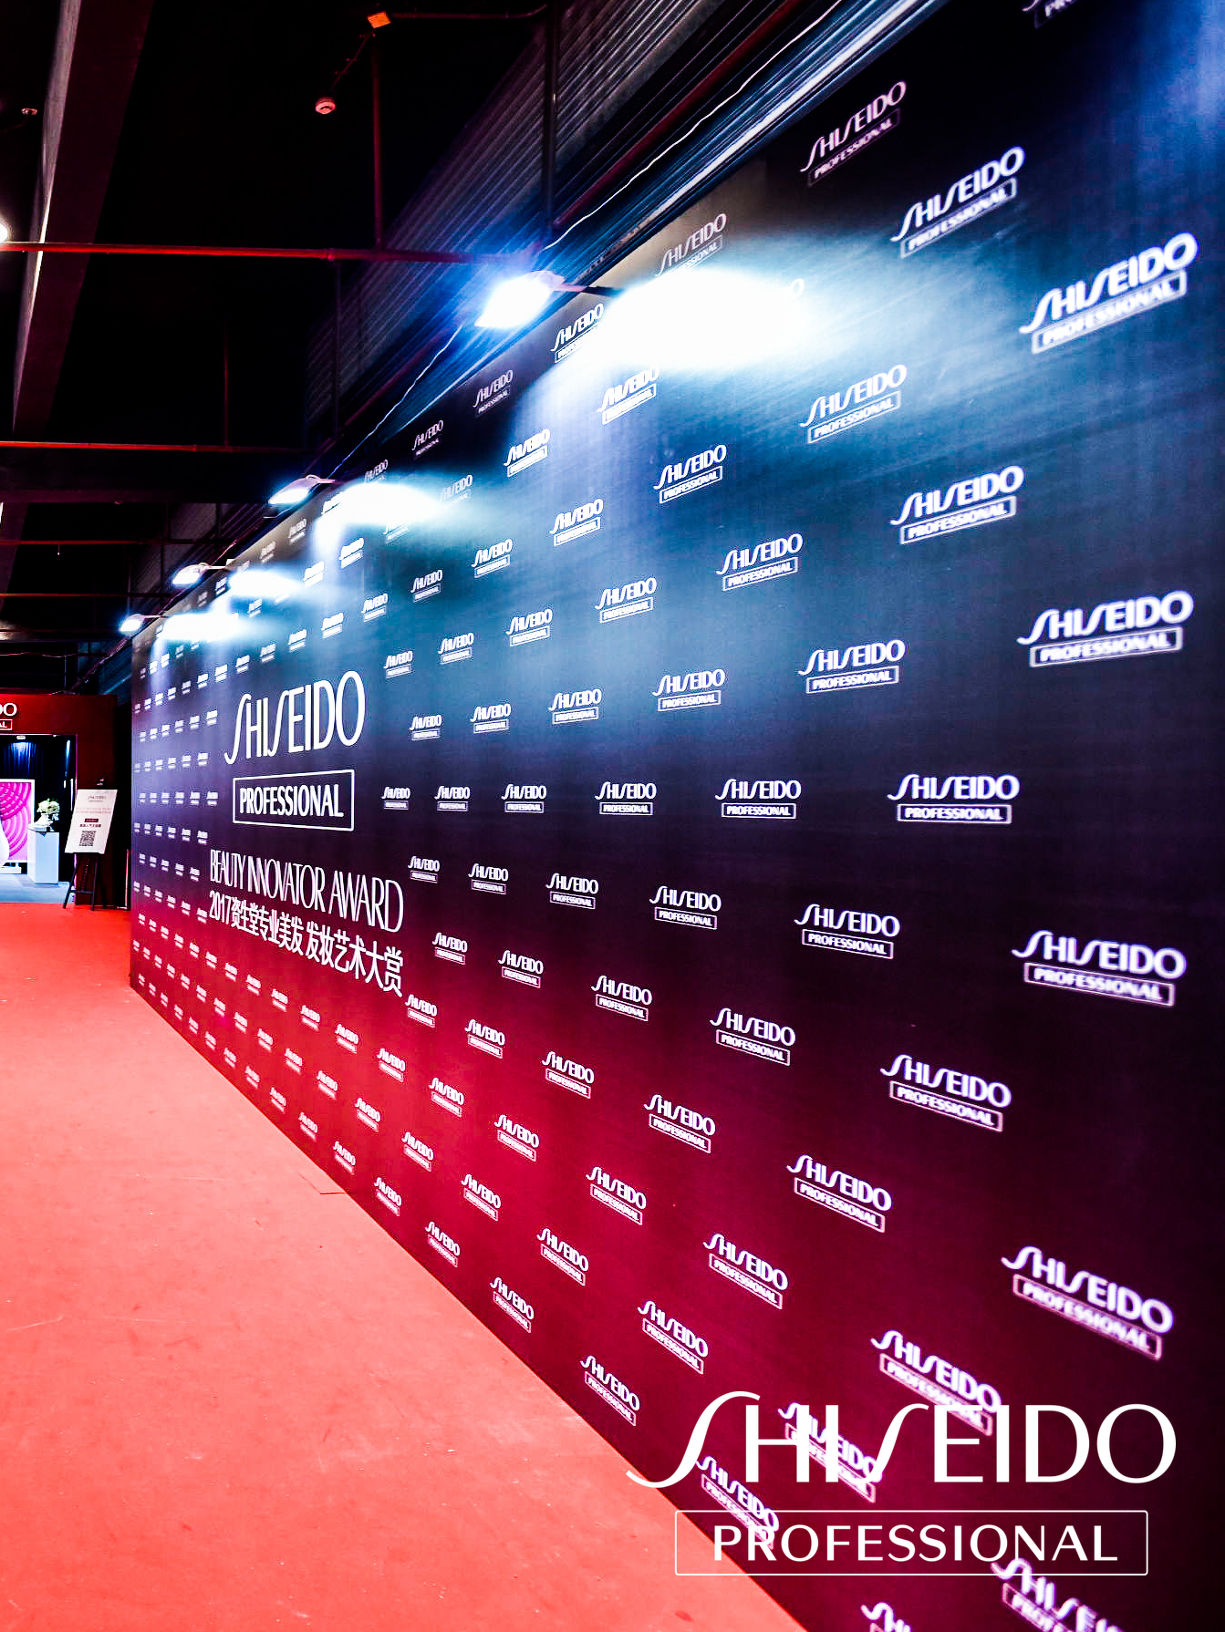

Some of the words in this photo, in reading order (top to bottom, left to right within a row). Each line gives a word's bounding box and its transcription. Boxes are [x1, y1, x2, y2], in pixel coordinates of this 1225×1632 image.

[800, 81, 906, 174] SHISEIDO
[814, 117, 894, 177] PROFESSIONAL
[890, 146, 1025, 243] SHISEIDO
[907, 187, 1008, 250] PROFESSIONAL
[655, 213, 727, 277] SHISEIDO
[1019, 233, 1198, 334] SHISEIDO
[550, 303, 604, 352] SHISEIDO
[1042, 279, 1175, 346] PROFESSIONAL
[472, 369, 514, 408] SHISEIDO
[800, 365, 906, 428] SHISEIDO
[815, 398, 894, 438] PROFESSIONAL
[503, 428, 551, 467] SHISEIDO
[654, 445, 726, 490] SHISEIDO
[664, 471, 718, 500] PROFESSIONAL
[890, 467, 1022, 525] SHISEIDO
[549, 499, 603, 534] SHISEIDO
[909, 503, 1007, 539] PROFESSIONAL
[471, 540, 512, 568] SHISEIDO
[716, 534, 802, 575] SHISEIDO
[728, 562, 792, 587] PROFESSIONAL
[594, 578, 657, 610] SHISEIDO
[505, 609, 553, 635] SHISEIDO
[1018, 594, 1191, 644] SHISEIDO
[798, 640, 904, 675] SHISEIDO
[1041, 634, 1170, 662] PROFESSIONAL
[652, 669, 725, 696] SHISEIDO
[813, 670, 892, 690] PROFESSIONAL
[224, 670, 366, 765] SHISEIDO
[469, 703, 511, 722] SHISEIDO
[548, 689, 602, 711] SHISEIDO
[662, 694, 716, 708] PROFESSIONAL
[239, 783, 344, 818] PROFESSIONAL
[500, 784, 547, 800] SHISEIDO
[594, 781, 656, 800] SHISEIDO
[715, 778, 801, 800] SHISEIDO
[887, 773, 1018, 800] SHISEIDO
[727, 805, 791, 816] PROFESSIONAL
[906, 807, 1003, 820] PROFESSIONAL
[210, 849, 246, 890] BEAUTY
[247, 855, 326, 913] INNOVATOR
[328, 870, 404, 933] AWARD
[467, 863, 509, 882] SHISEIDO
[545, 873, 599, 895] SHISEIDO
[649, 886, 721, 912] SHISEIDO
[659, 910, 713, 926] PROFESSIONAL
[794, 904, 899, 937] SHISEIDO
[305, 920, 403, 998] 发妆艺术大赏
[498, 950, 543, 975] SHISEIDO
[809, 933, 887, 955] PROFESSIONAL
[1012, 931, 1184, 977] SHISEIDO
[591, 975, 652, 1005] SHISEIDO
[1035, 968, 1162, 1000] PROFESSIONAL
[464, 1019, 505, 1046] SHISEIDO
[710, 1008, 795, 1046] SHISEIDO
[721, 1034, 785, 1061] PROFESSIONAL
[541, 1051, 594, 1084] SHISEIDO
[880, 1055, 1010, 1107] SHISEIDO
[643, 1095, 715, 1136] SHISEIDO
[898, 1087, 994, 1126] PROFESSIONAL
[494, 1114, 539, 1148] SHISEIDO
[653, 1118, 706, 1149] PROFESSIONAL
[460, 1174, 501, 1209] SHISEIDO
[585, 1167, 646, 1209] SHISEIDO
[786, 1155, 891, 1211] SHISEIDO
[801, 1183, 878, 1226] PROFESSIONAL
[536, 1228, 589, 1272] SHISEIDO
[703, 1234, 787, 1290] SHISEIDO
[490, 1278, 534, 1320] SHISEIDO
[714, 1259, 777, 1304] PROFESSIONAL
[1001, 1248, 1171, 1330] SHISEIDO
[637, 1301, 708, 1357] SHISEIDO
[1024, 1283, 1150, 1350] PROFESSIONAL
[647, 1324, 699, 1369] PROFESSIONAL
[580, 1356, 639, 1411] SHISEIDO
[870, 1330, 1002, 1414] SHISEIDO
[696, 1455, 780, 1531] SHISEIDO
